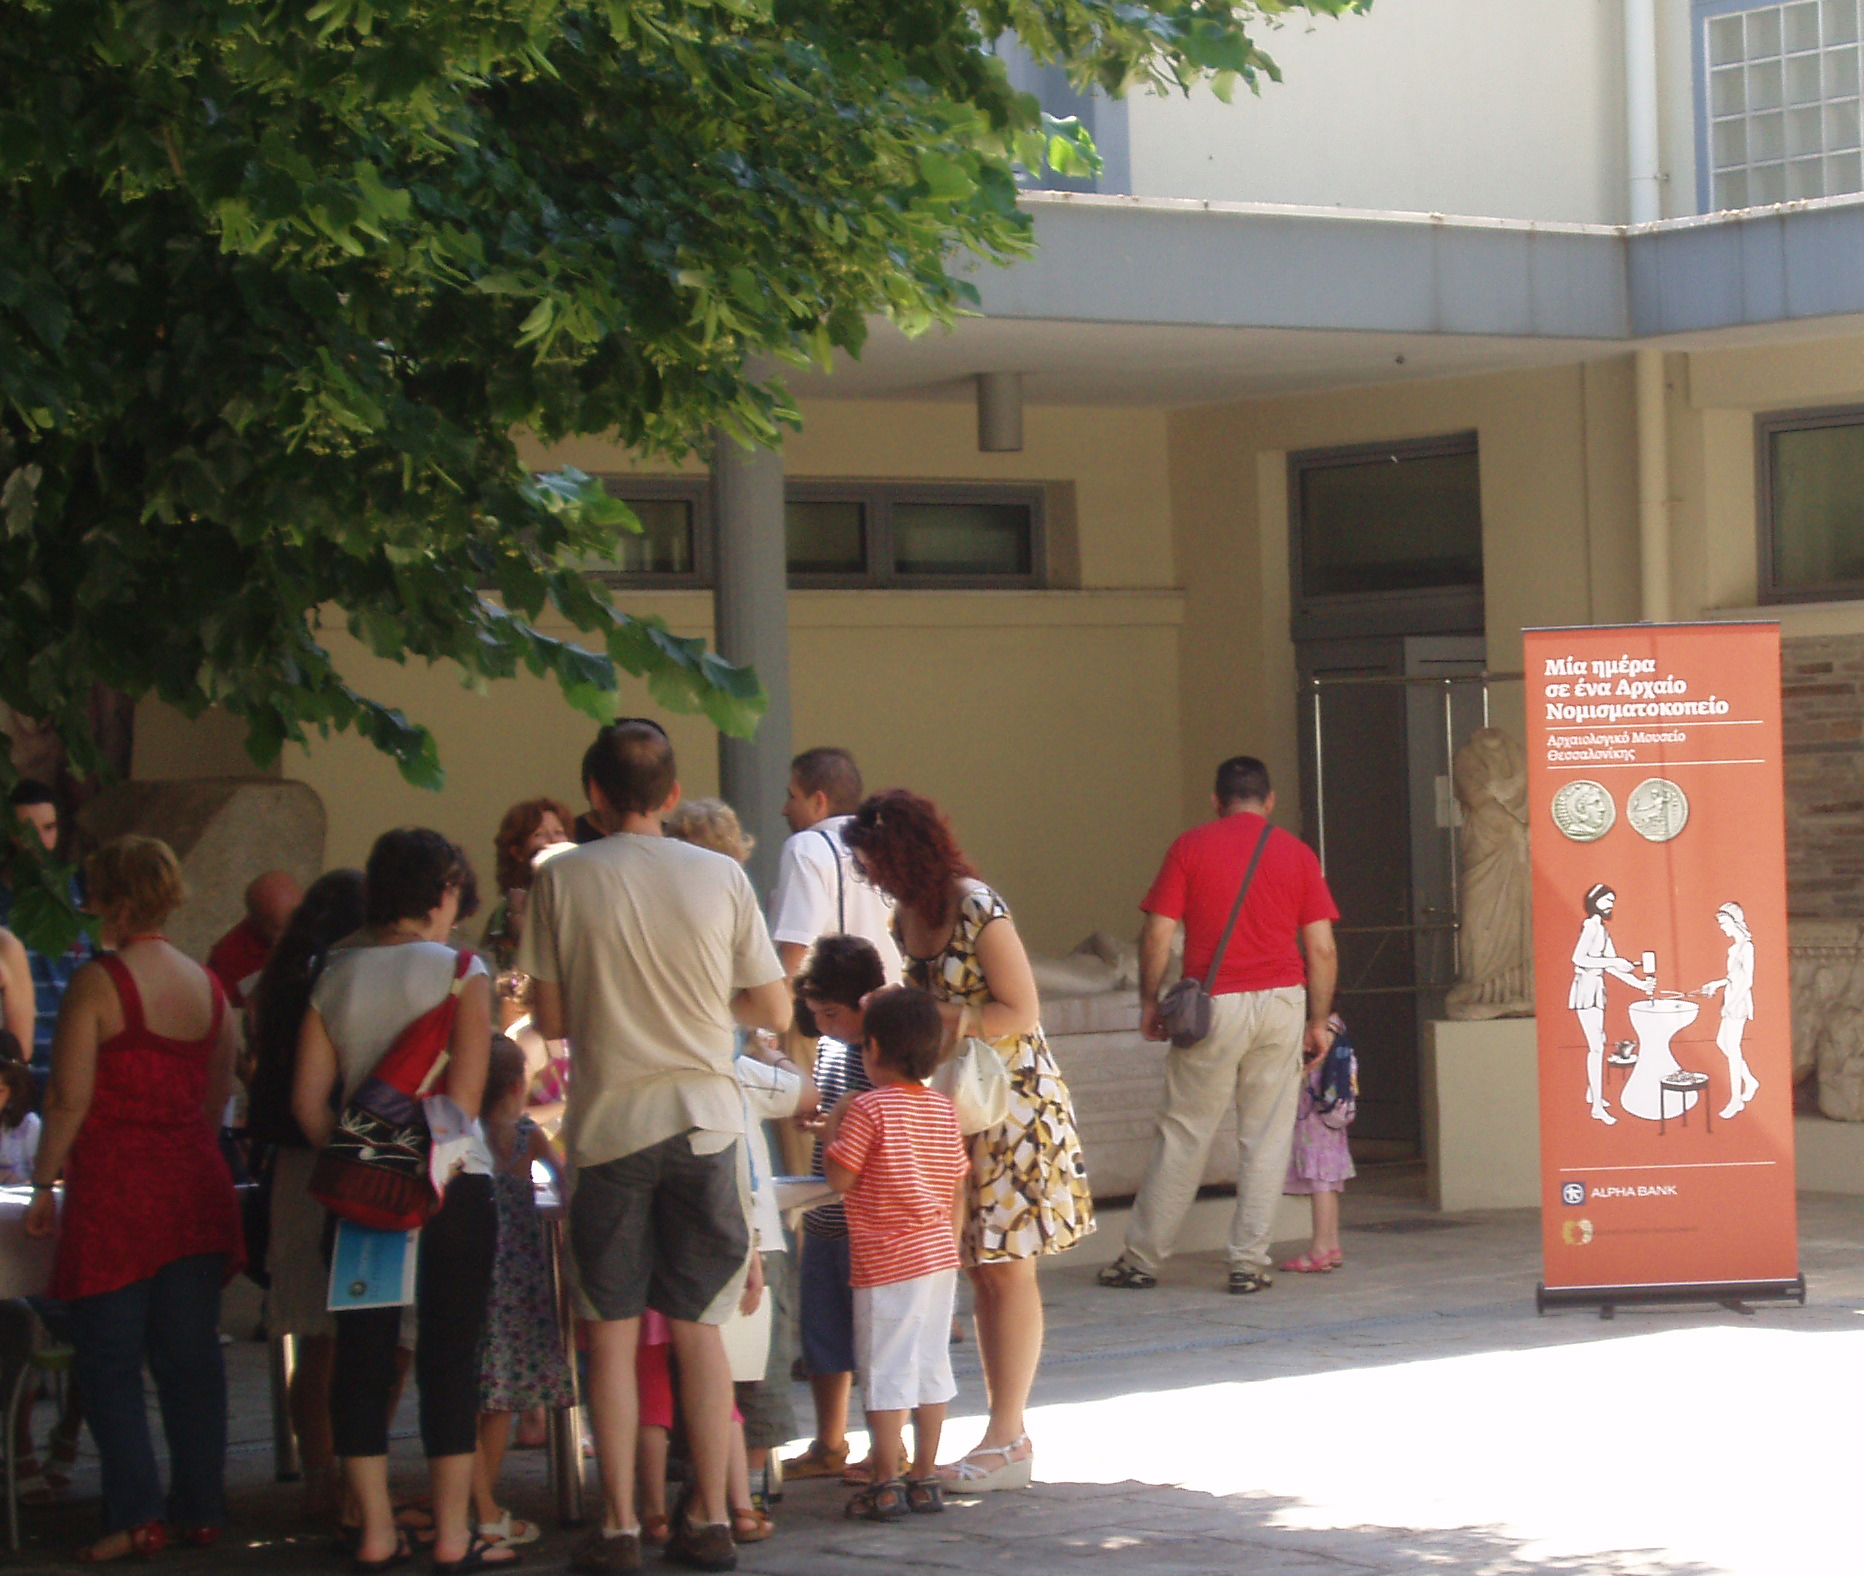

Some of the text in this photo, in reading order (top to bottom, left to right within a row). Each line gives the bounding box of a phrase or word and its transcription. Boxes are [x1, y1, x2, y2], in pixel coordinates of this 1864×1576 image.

[1544, 655, 1656, 677] Μία ημέρα
[1545, 675, 1688, 699] σε ένα Αρχαίο
[1545, 696, 1730, 723] Νομισματοκοπείο
[1547, 729, 1687, 747] Αρχαιολογικό Μουσείο
[1547, 747, 1636, 762] Θεσσαλονίκης
[1591, 1185, 1678, 1198] ALPHA BANK
